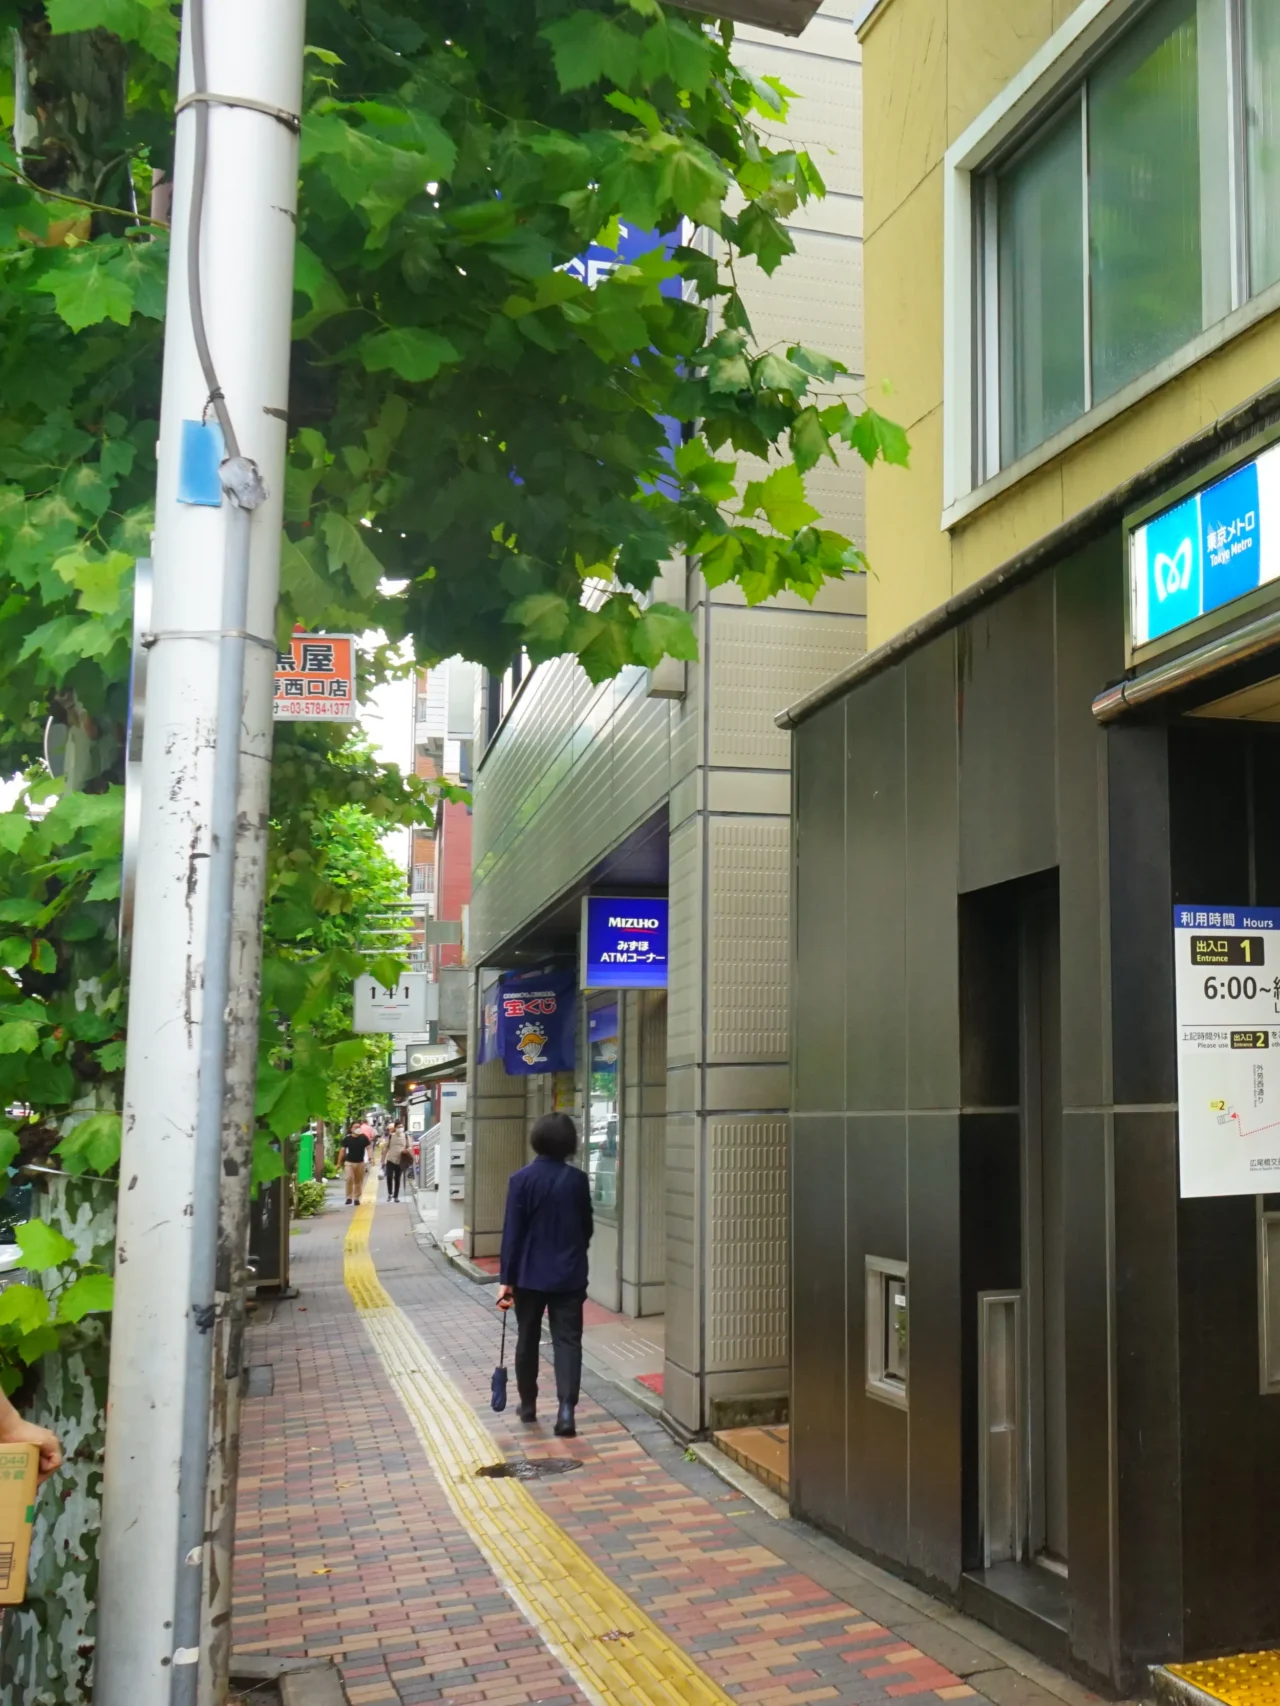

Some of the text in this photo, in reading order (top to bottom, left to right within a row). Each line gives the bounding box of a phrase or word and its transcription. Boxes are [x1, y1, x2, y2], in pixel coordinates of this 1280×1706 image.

[1207, 511, 1255, 552] 東京メトロ
[1210, 538, 1253, 567] Tokyo Metro
[608, 917, 659, 928] MIZUHO
[1181, 912, 1274, 928] 利用時間 Hours
[617, 940, 649, 951] みずほ
[1196, 939, 1251, 962] 出入口 1
[600, 952, 665, 963] ATMコーナー
[504, 999, 556, 1017] 宝くじ
[1182, 1032, 1228, 1041] 上記時間外は
[1233, 1033, 1253, 1042] 出入口
[1256, 1032, 1265, 1047] 2
